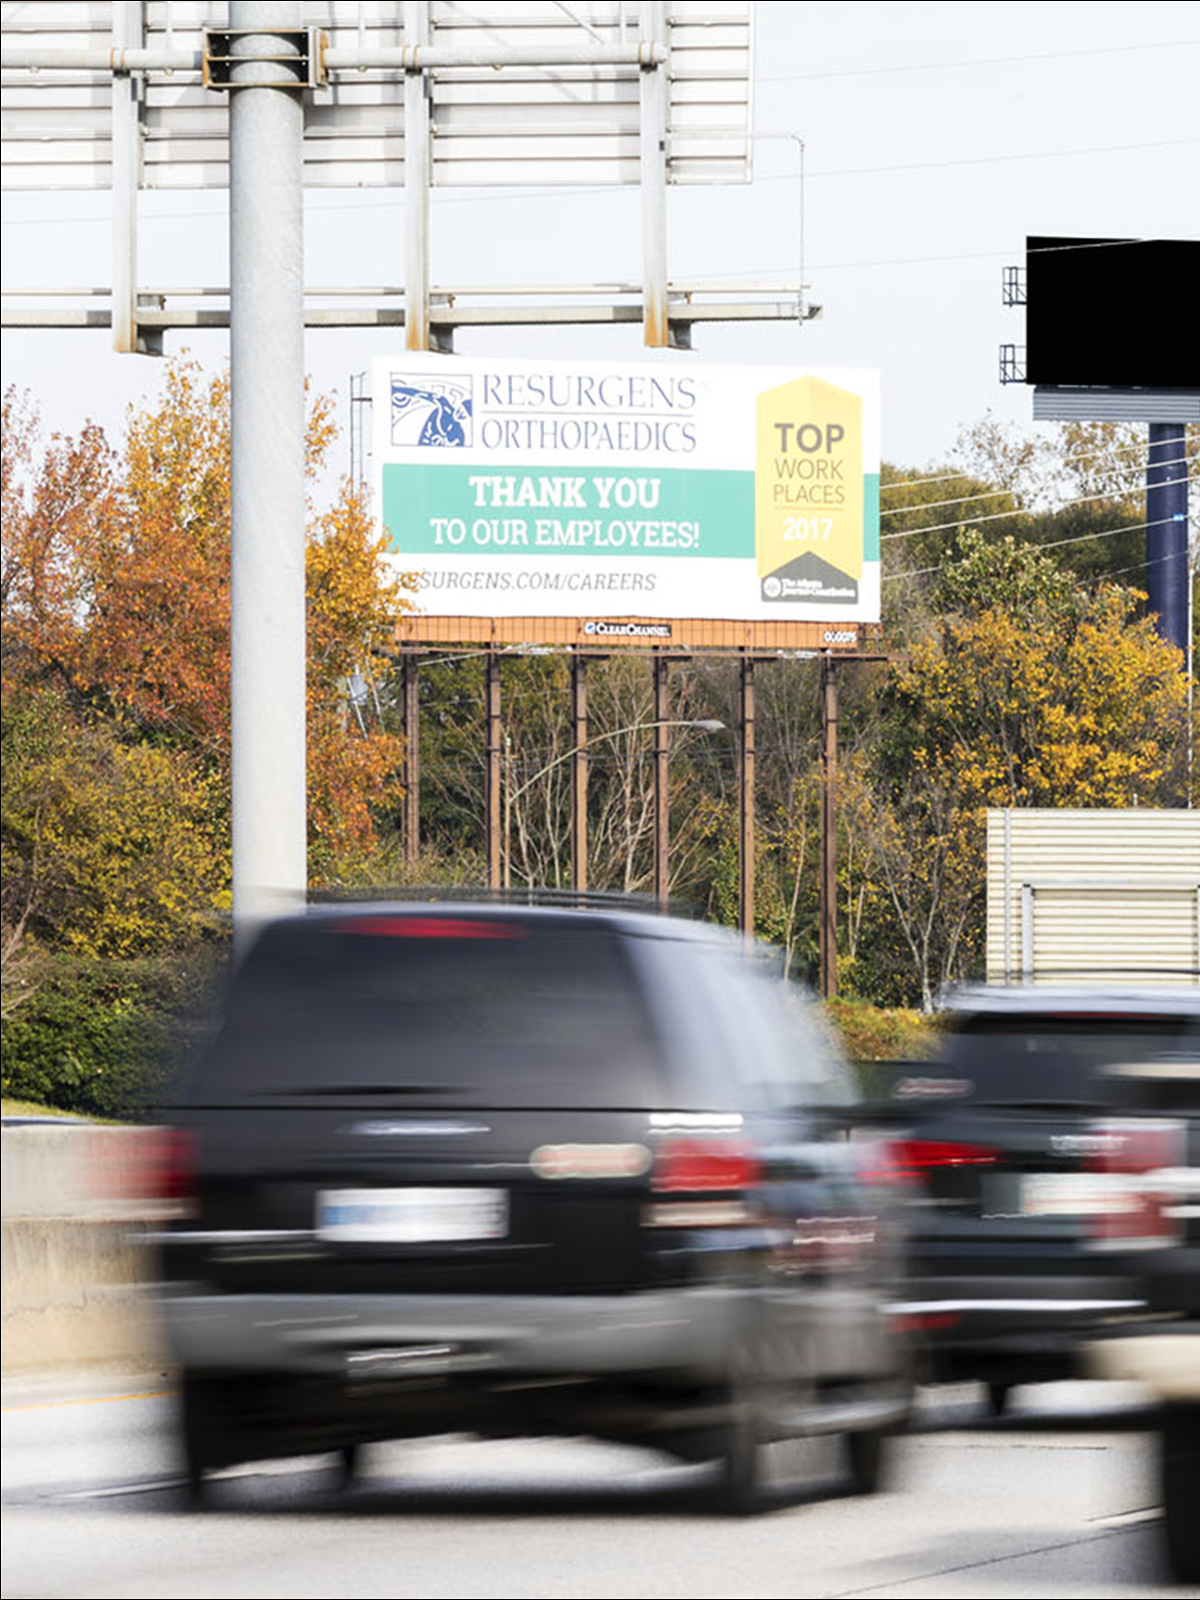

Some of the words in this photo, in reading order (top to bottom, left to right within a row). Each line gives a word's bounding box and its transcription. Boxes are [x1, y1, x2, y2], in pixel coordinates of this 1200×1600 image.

[483, 374, 697, 409] RESURGENS
[481, 418, 697, 453] ORTHOPAEDICS
[774, 422, 845, 454] TOP
[774, 458, 844, 480] WORK
[468, 476, 587, 507] THANK
[593, 477, 661, 508] YOU
[773, 484, 845, 504] PLACES
[430, 518, 466, 545] TO
[472, 519, 528, 545] OUR
[535, 519, 700, 548] EMPLOYEES!
[782, 517, 832, 541] 2017
